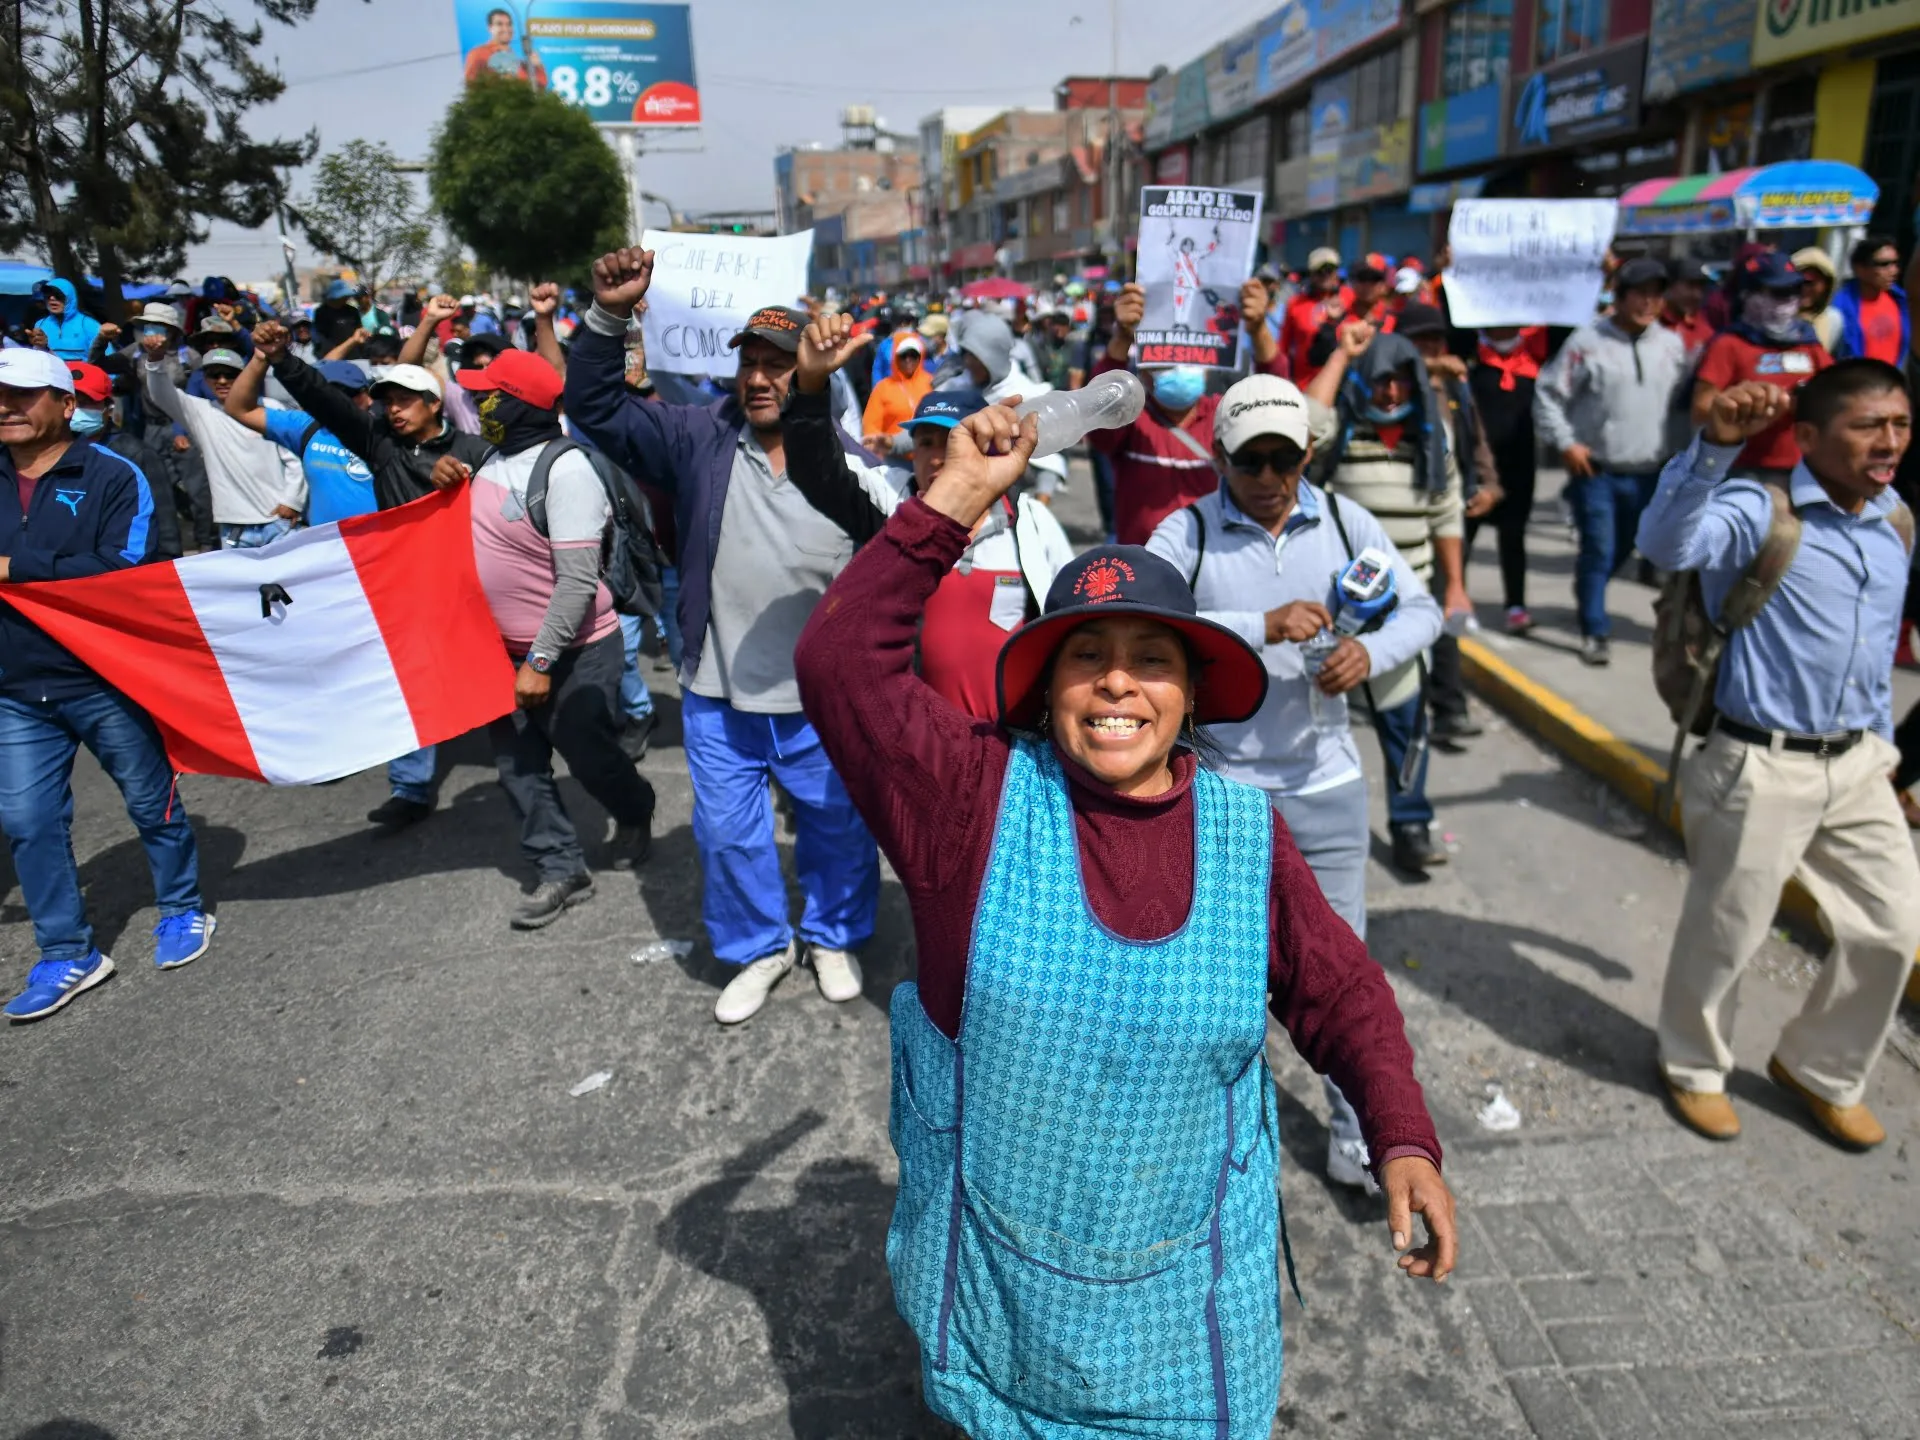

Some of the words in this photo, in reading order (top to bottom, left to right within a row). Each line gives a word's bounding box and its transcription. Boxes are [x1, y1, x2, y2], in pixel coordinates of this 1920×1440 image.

[1166, 190, 1214, 206] ABAJO
[1217, 193, 1236, 208] EL
[1148, 204, 1184, 216] GOLPE
[1185, 205, 1201, 217] DE
[1204, 207, 1252, 221] ESTADO
[691, 286, 736, 308] DEL
[1137, 331, 1163, 344] DINA
[1142, 345, 1218, 364] ASESINA
[1111, 558, 1136, 582] CARITAS
